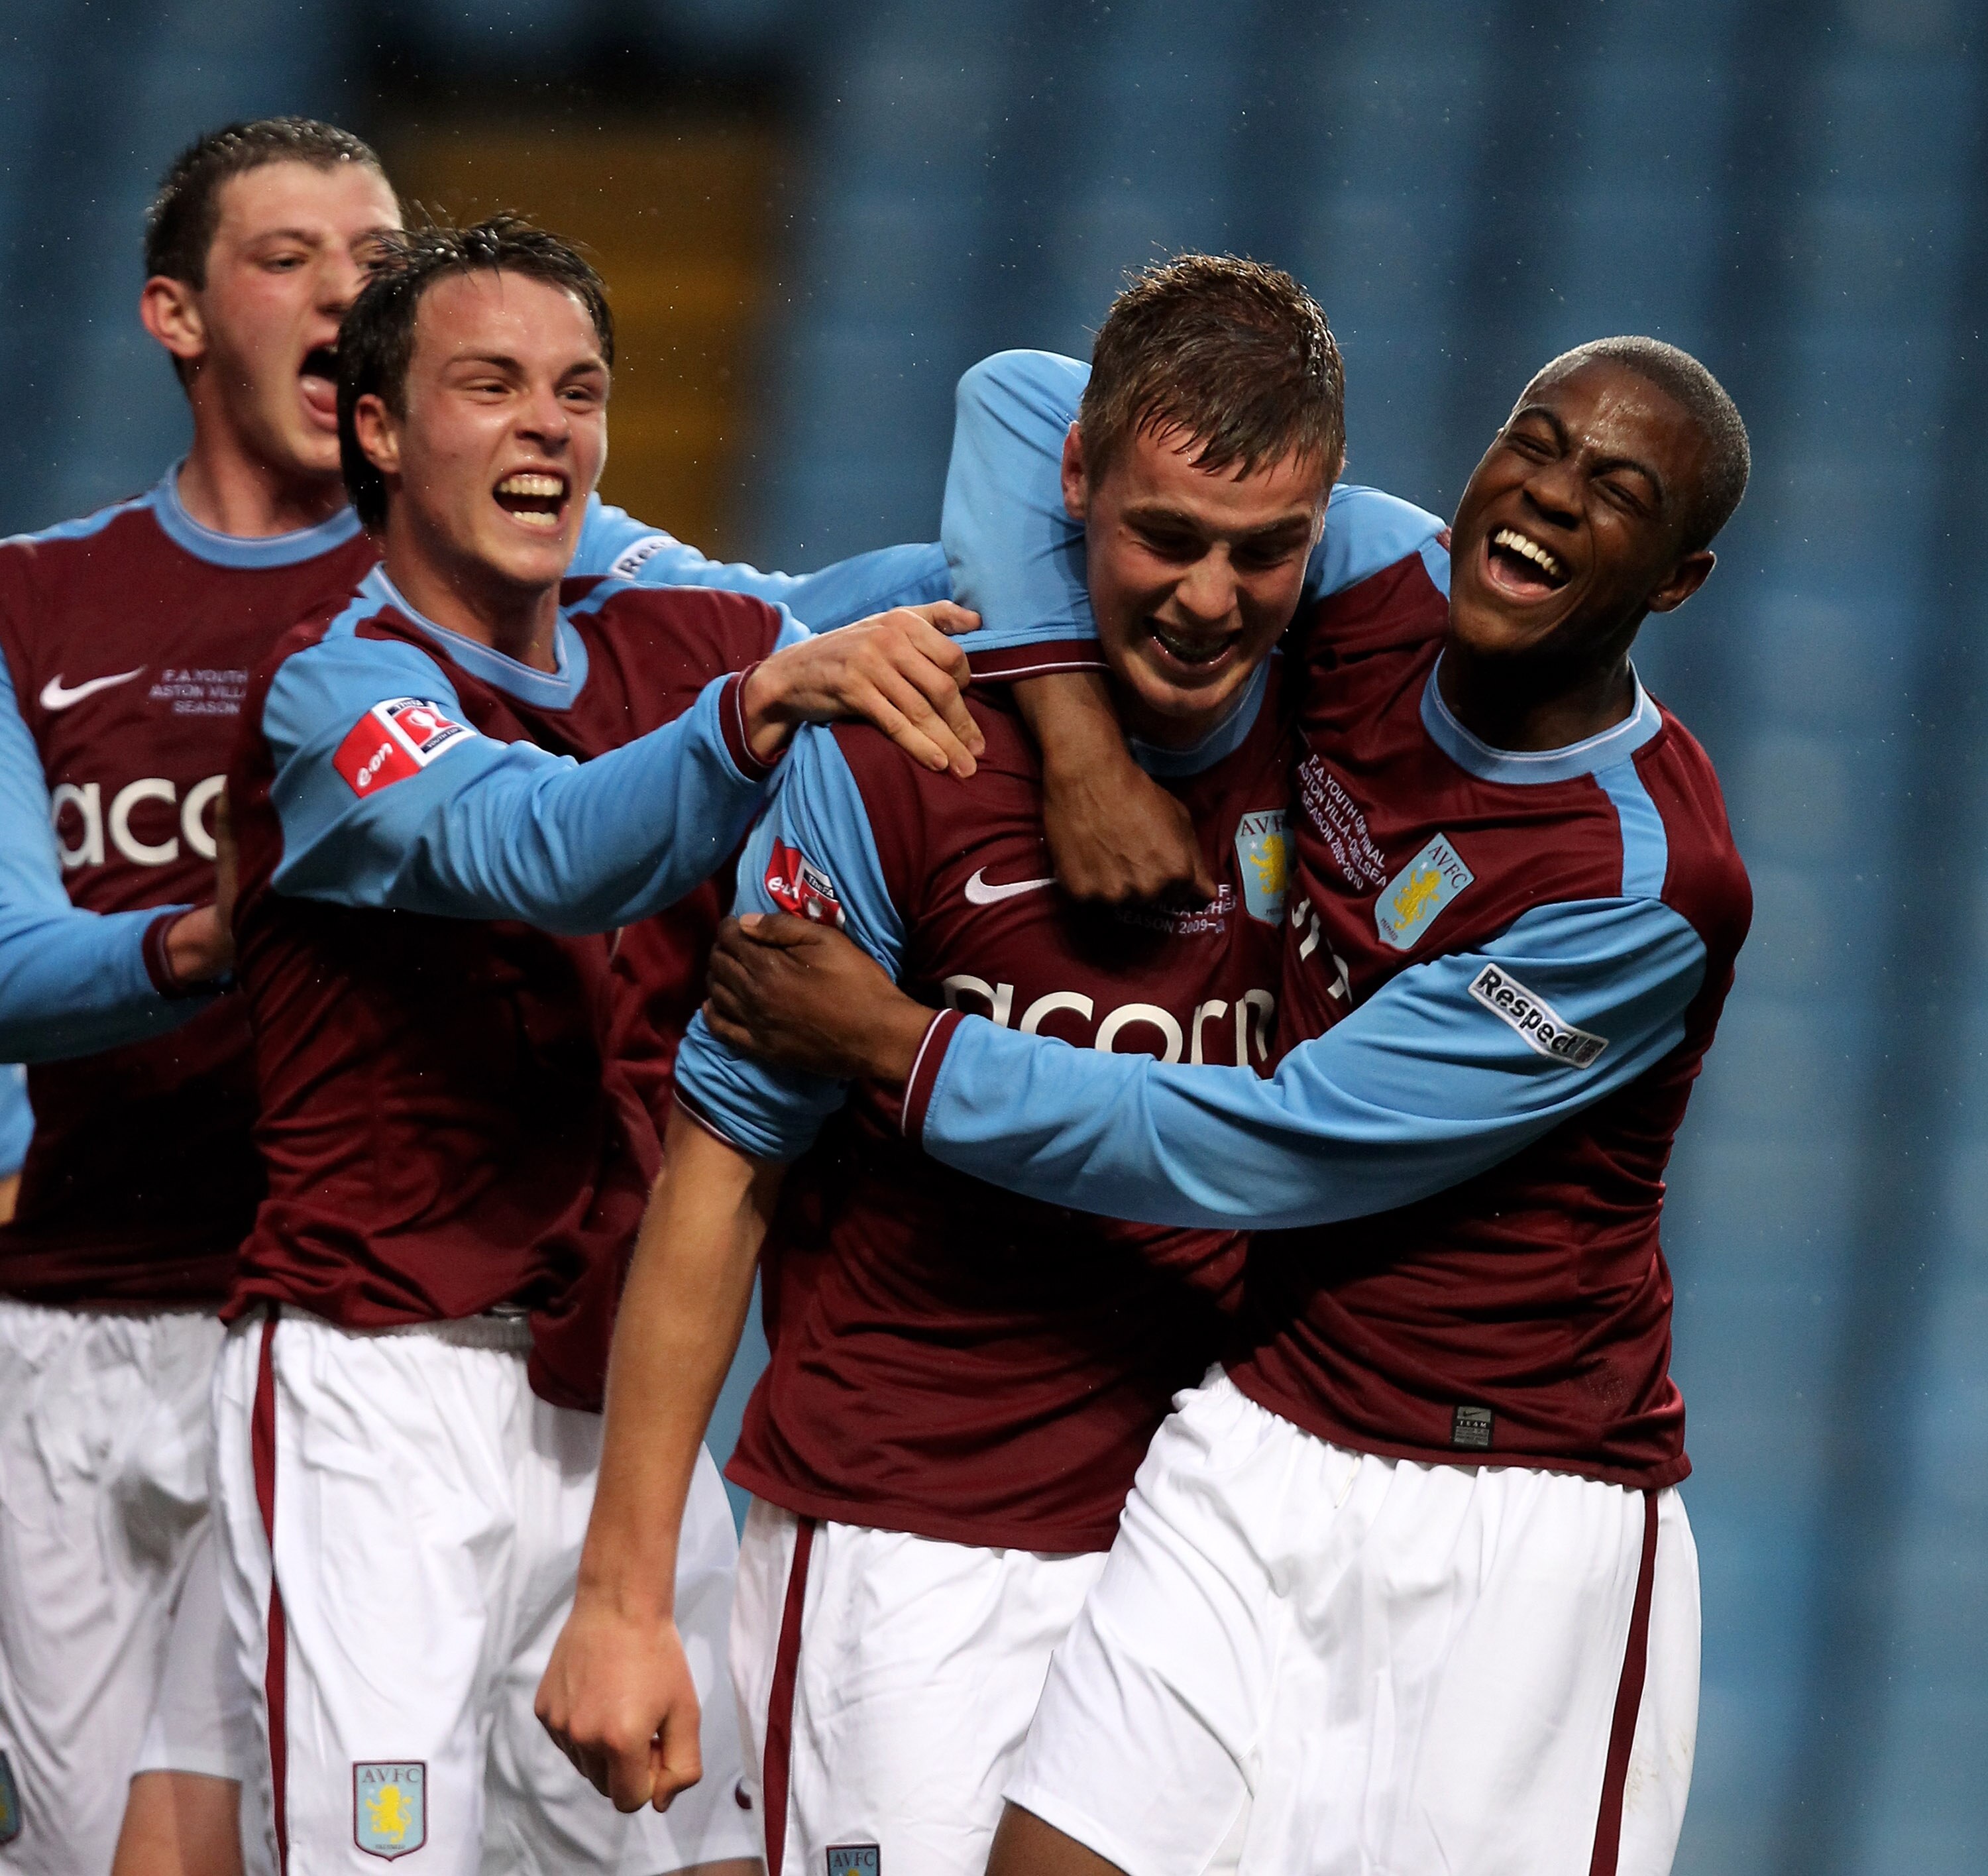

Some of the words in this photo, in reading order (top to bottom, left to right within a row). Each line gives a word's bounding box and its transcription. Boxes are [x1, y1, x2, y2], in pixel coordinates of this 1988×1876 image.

[174, 700, 239, 713] SEASON
[1298, 761, 1326, 803] ASTON
[1325, 798, 1351, 838] VILLA
[1302, 790, 1336, 843] SEASON
[1325, 774, 1358, 819] YOUTH
[1360, 833, 1385, 869] FINAL
[1240, 815, 1286, 837] AVF
[1427, 844, 1468, 889] AVFC
[1477, 969, 1578, 1053] Respect
[362, 1767, 421, 1783] AVFC
[834, 1851, 875, 1867] AVFC
